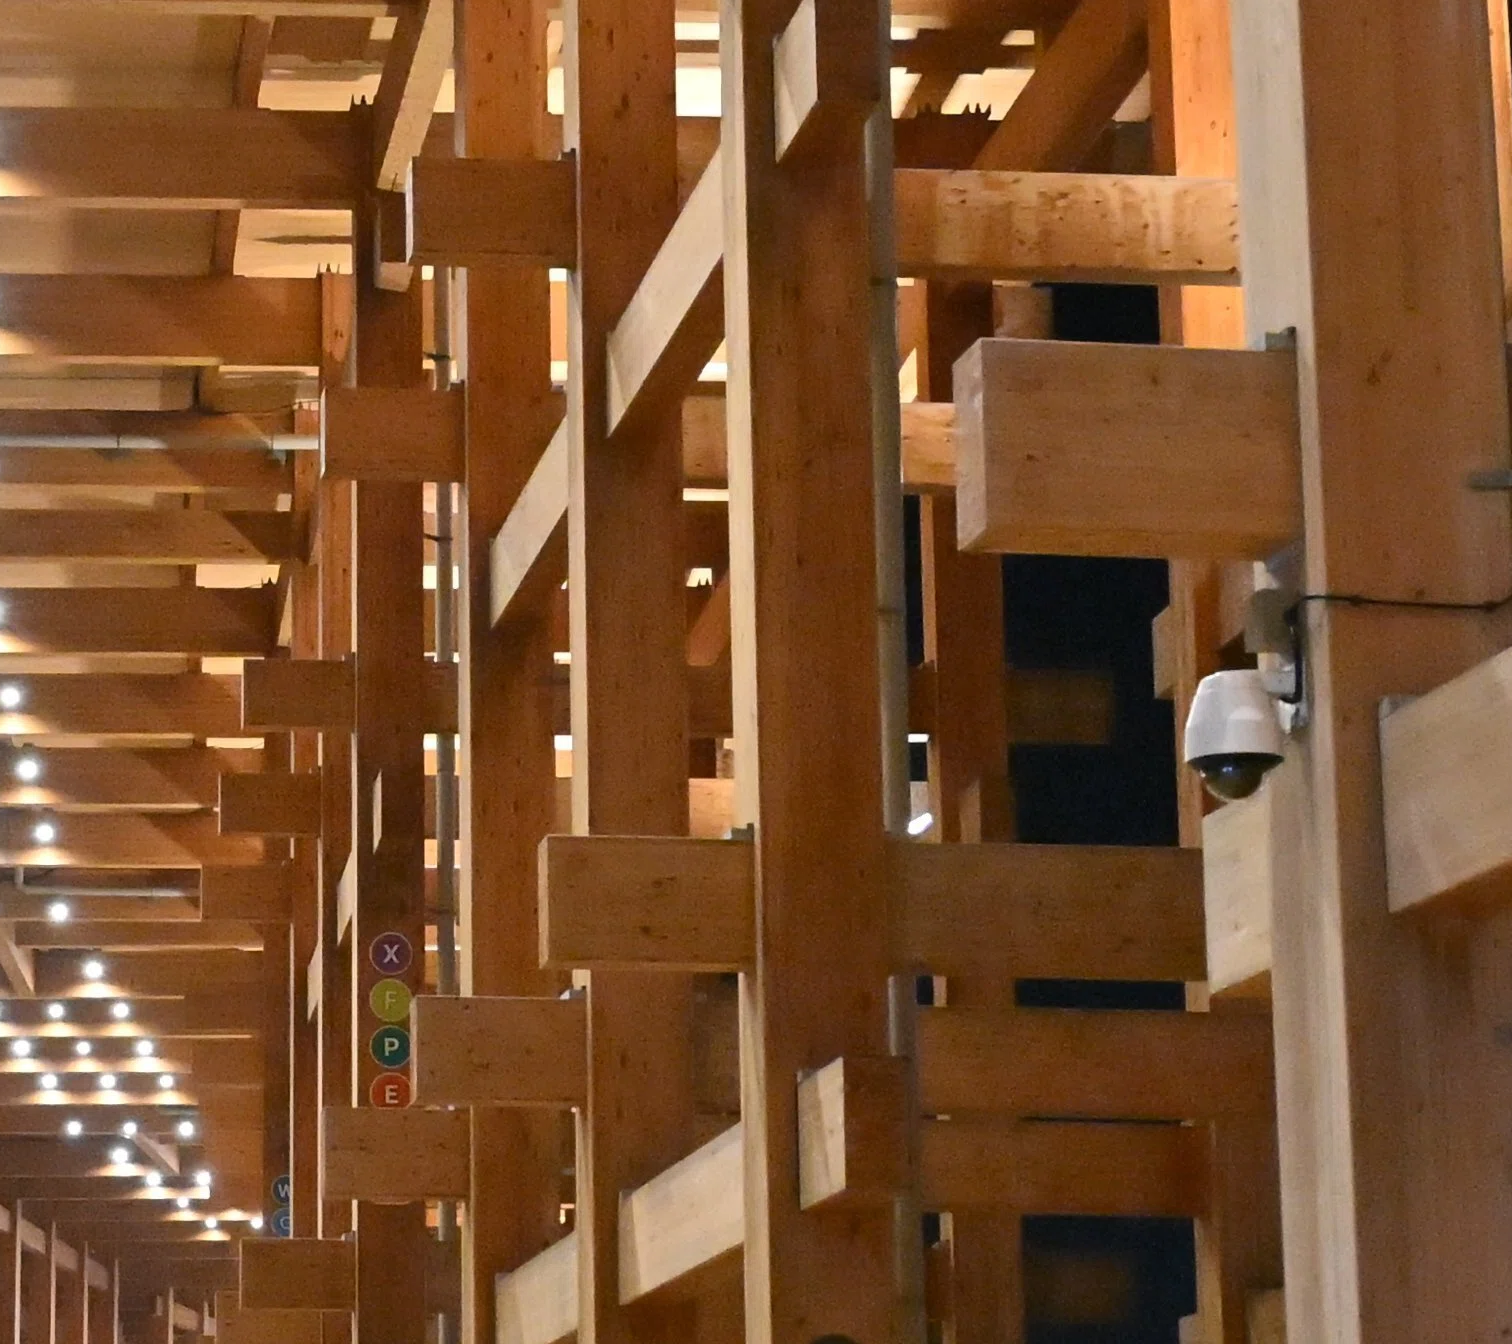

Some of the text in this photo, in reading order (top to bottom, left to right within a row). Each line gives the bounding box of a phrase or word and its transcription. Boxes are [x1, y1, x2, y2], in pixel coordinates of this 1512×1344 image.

[383, 943, 400, 964] X
[384, 990, 397, 1010] F
[383, 1037, 400, 1057] P
[384, 1084, 399, 1105] E
